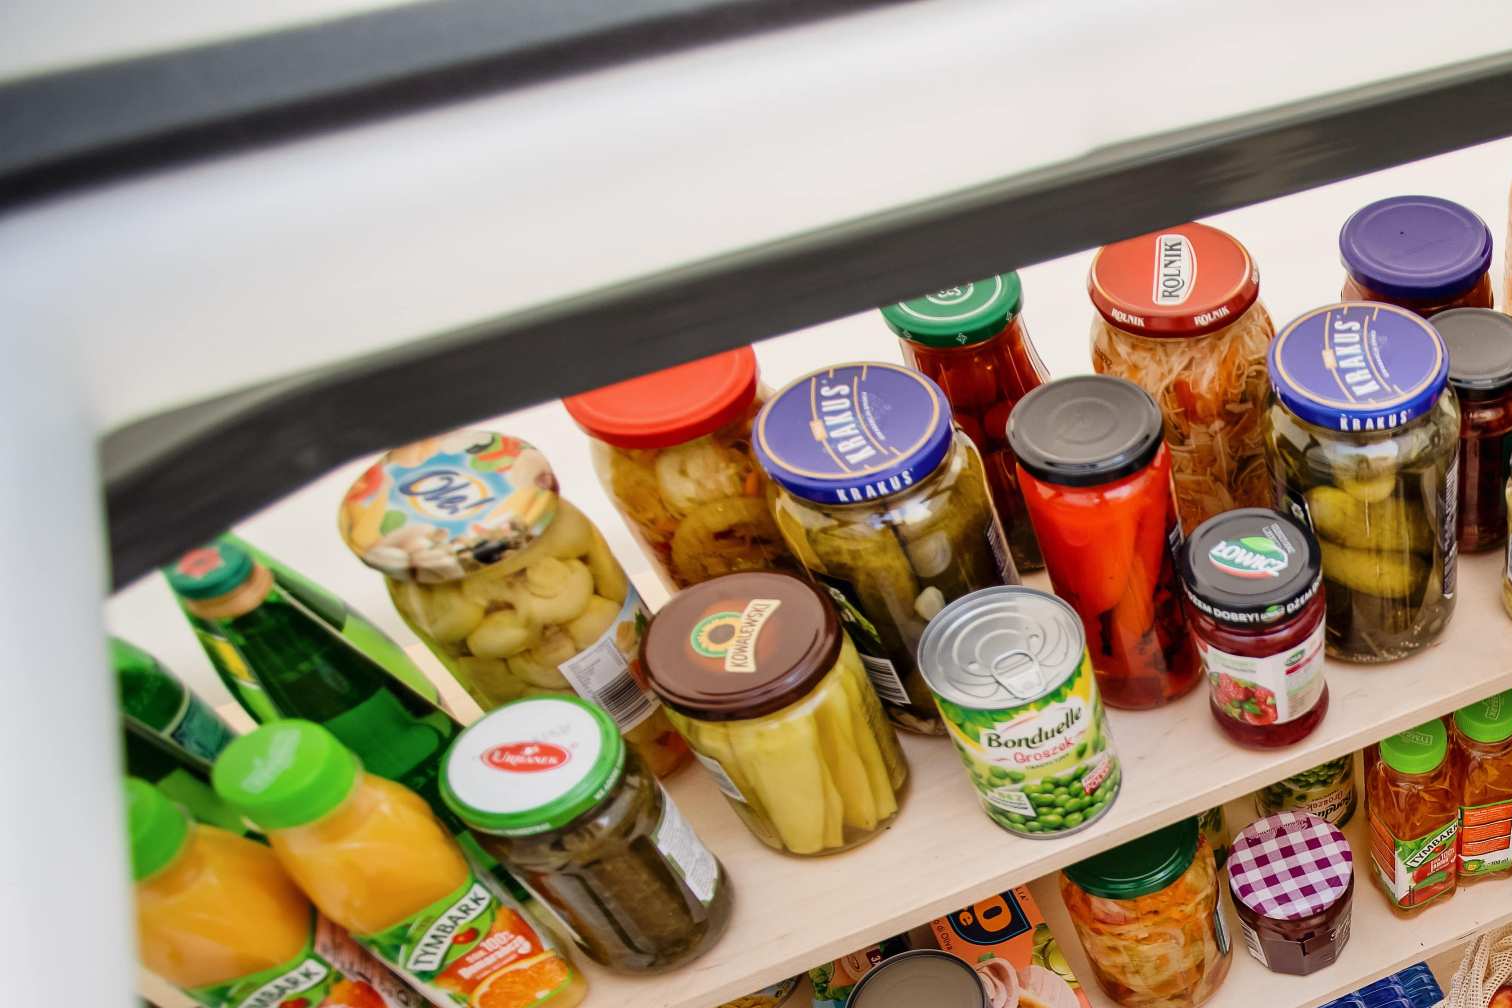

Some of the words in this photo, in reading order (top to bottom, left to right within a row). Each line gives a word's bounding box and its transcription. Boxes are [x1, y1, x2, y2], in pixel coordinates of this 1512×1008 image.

[1161, 240, 1185, 299] ROLNIK
[1111, 307, 1145, 328] ROLNIK
[1194, 304, 1231, 327] ROLNIK
[1333, 319, 1381, 397] KRAKUS
[820, 383, 877, 465] KRAKUS
[1339, 411, 1409, 431] KRAKUS
[835, 469, 913, 503] KRAKUS
[730, 602, 773, 668] KOWALEWSKI
[986, 705, 1083, 750] Bonduelle
[1013, 735, 1075, 764] Groszek
[411, 890, 487, 968] TYMBARK
